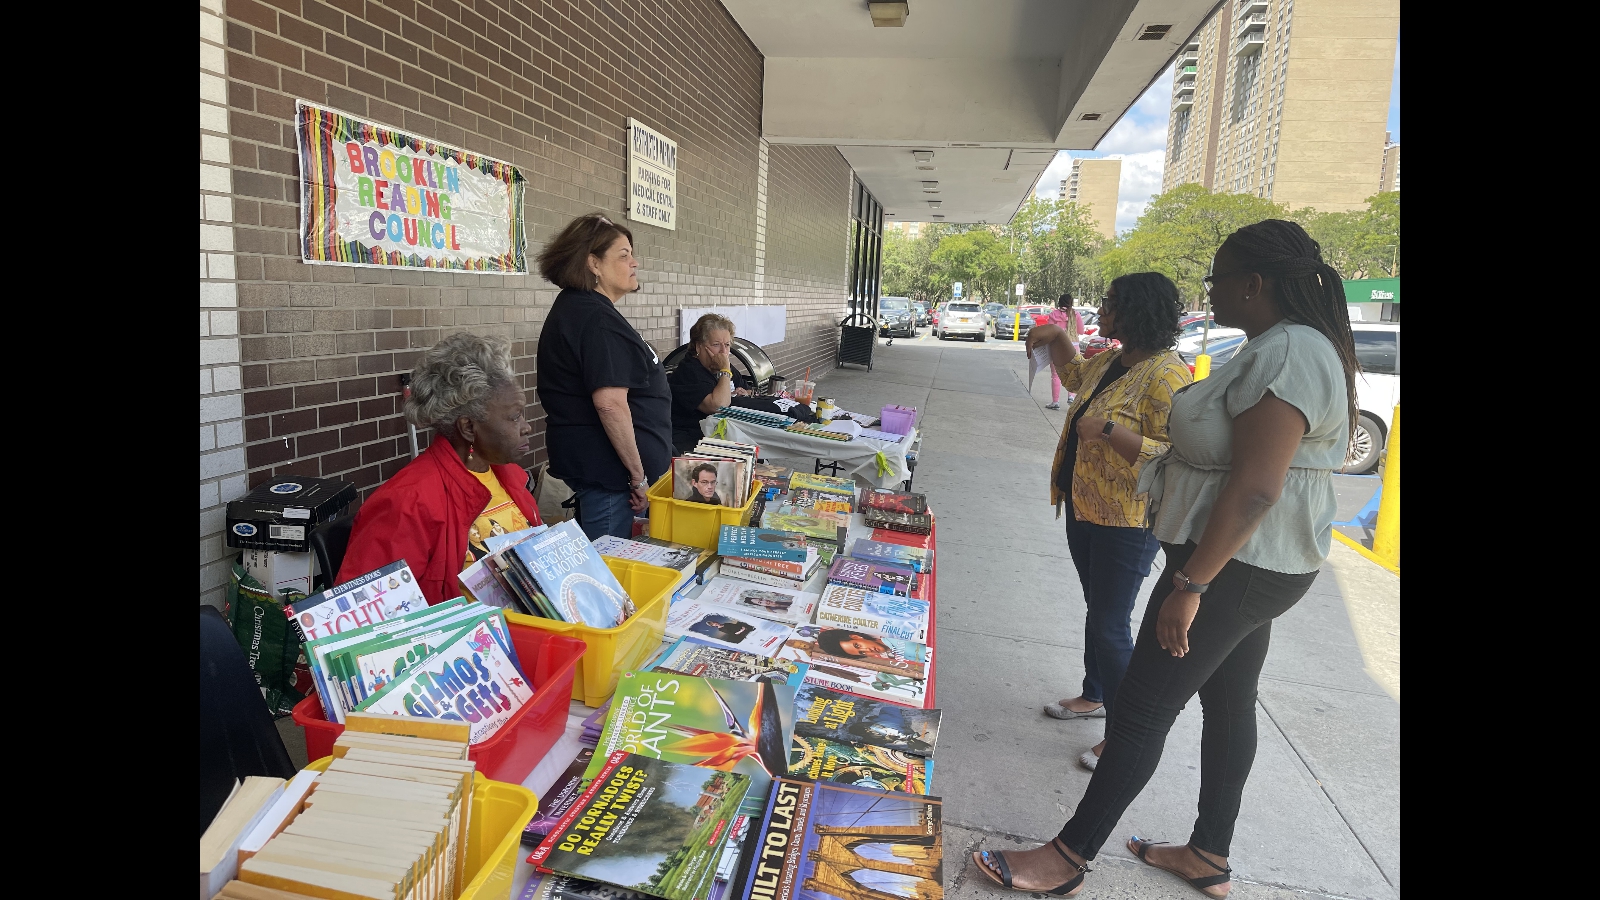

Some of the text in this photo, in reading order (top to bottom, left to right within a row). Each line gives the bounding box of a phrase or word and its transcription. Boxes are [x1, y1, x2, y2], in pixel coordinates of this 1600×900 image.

[346, 142, 460, 193] BROOKLYN
[638, 166, 671, 191] PARKING FOR
[358, 177, 451, 220] READING
[633, 182, 656, 203] MEDICAL
[369, 210, 461, 251] COUNCIL
[636, 202, 671, 223] & STAFF ONLY
[529, 549, 563, 574] ENERGY,
[558, 536, 589, 558] FORCES
[544, 550, 590, 581] & MOTION
[251, 605, 265, 651] Christmas
[819, 611, 852, 626] CATHERINE
[852, 616, 879, 629] COULTER
[881, 624, 915, 641] FINAL CUT
[440, 681, 512, 723] & GETS
[805, 676, 854, 692] STUME BOOK
[622, 684, 655, 754] ORLD OF
[531, 846, 551, 860] Q&A
[610, 752, 625, 765] Q&A
[548, 775, 580, 809] THE USBORNE
[554, 792, 578, 817] INTERNET
[558, 765, 634, 853] DO TORNADOES
[771, 783, 799, 830] LAST
[576, 768, 649, 856] REALLY TWIST?
[763, 833, 789, 862] TO
